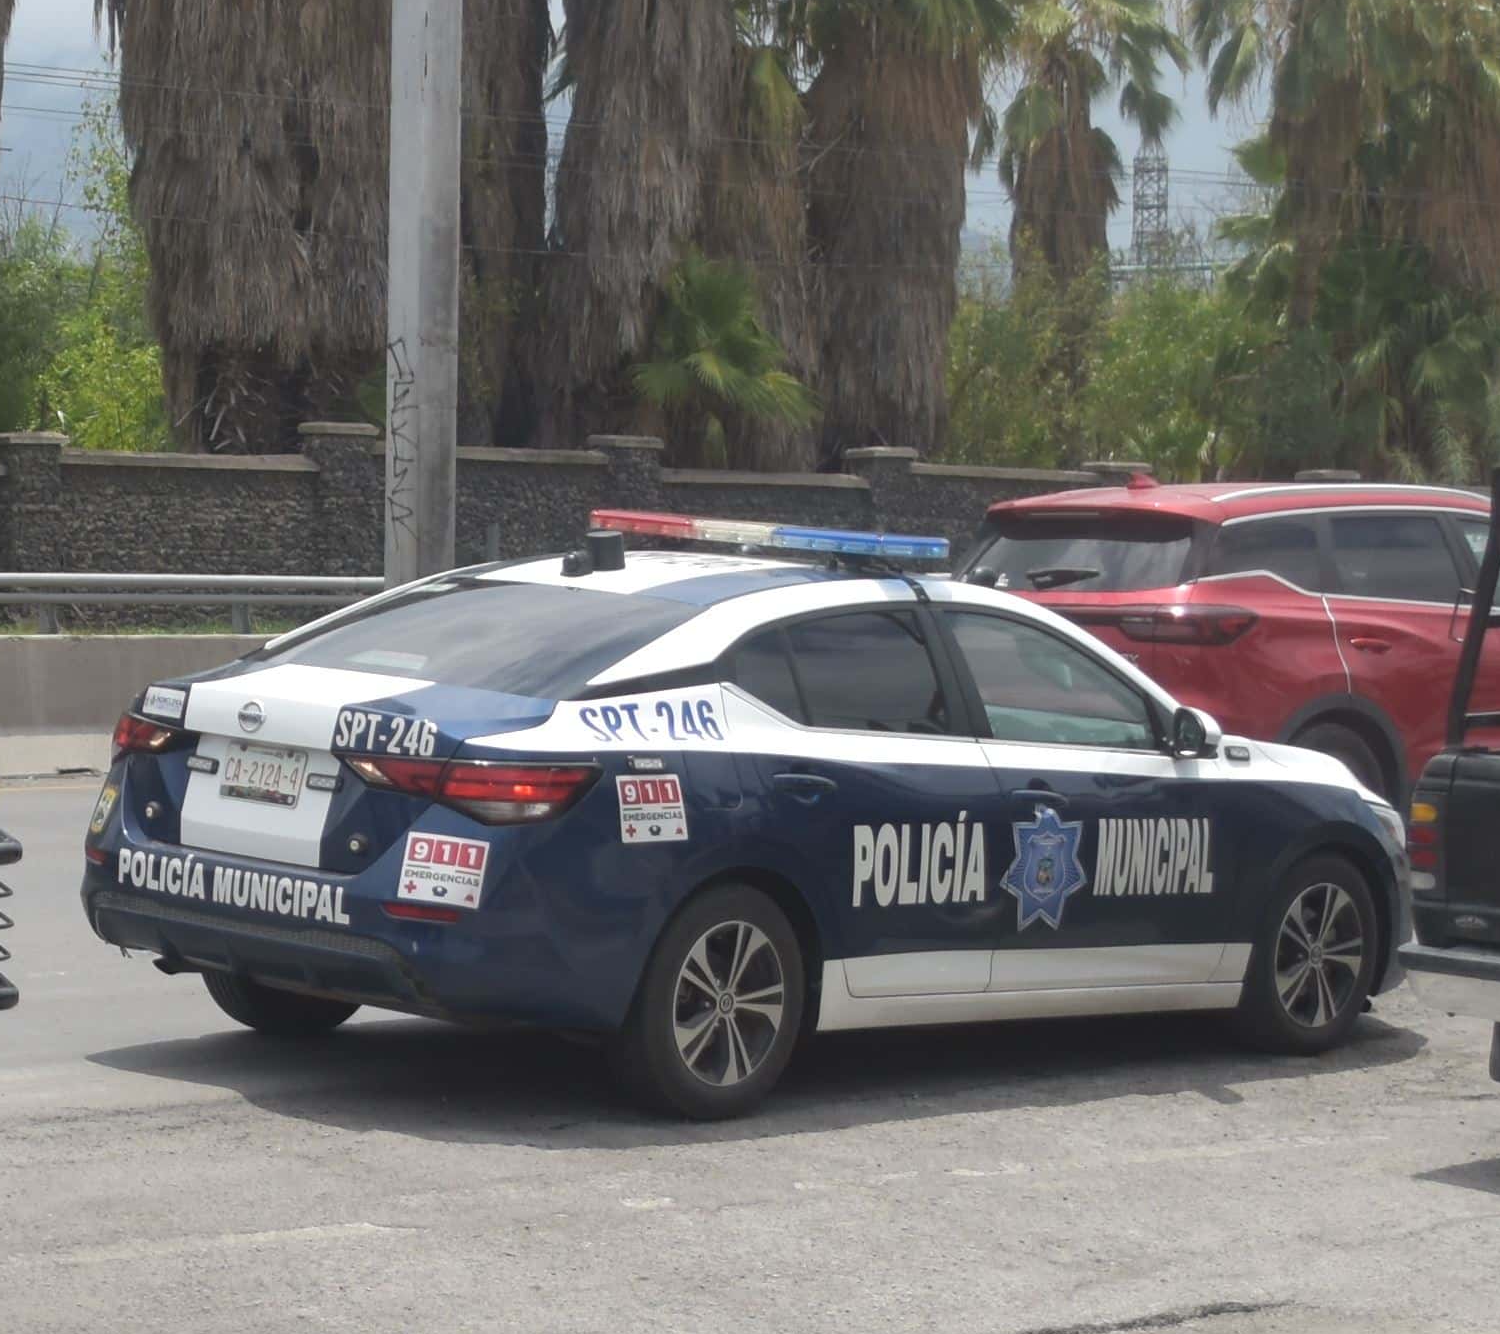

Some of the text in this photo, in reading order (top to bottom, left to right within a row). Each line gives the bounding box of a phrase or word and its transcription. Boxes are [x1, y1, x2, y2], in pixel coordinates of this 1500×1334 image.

[335, 710, 438, 756] SPT-246
[578, 699, 725, 742] SPT-246
[224, 756, 299, 790] CA-212A-4
[624, 782, 674, 803] 911
[623, 810, 683, 822] EMERGENCIAS
[413, 841, 478, 866] 911
[852, 810, 1213, 907] POLICÍA MUNICIPAL
[118, 847, 350, 925] POLICÍA MUNICIPAL
[404, 868, 480, 887] EMERGENCIAS
